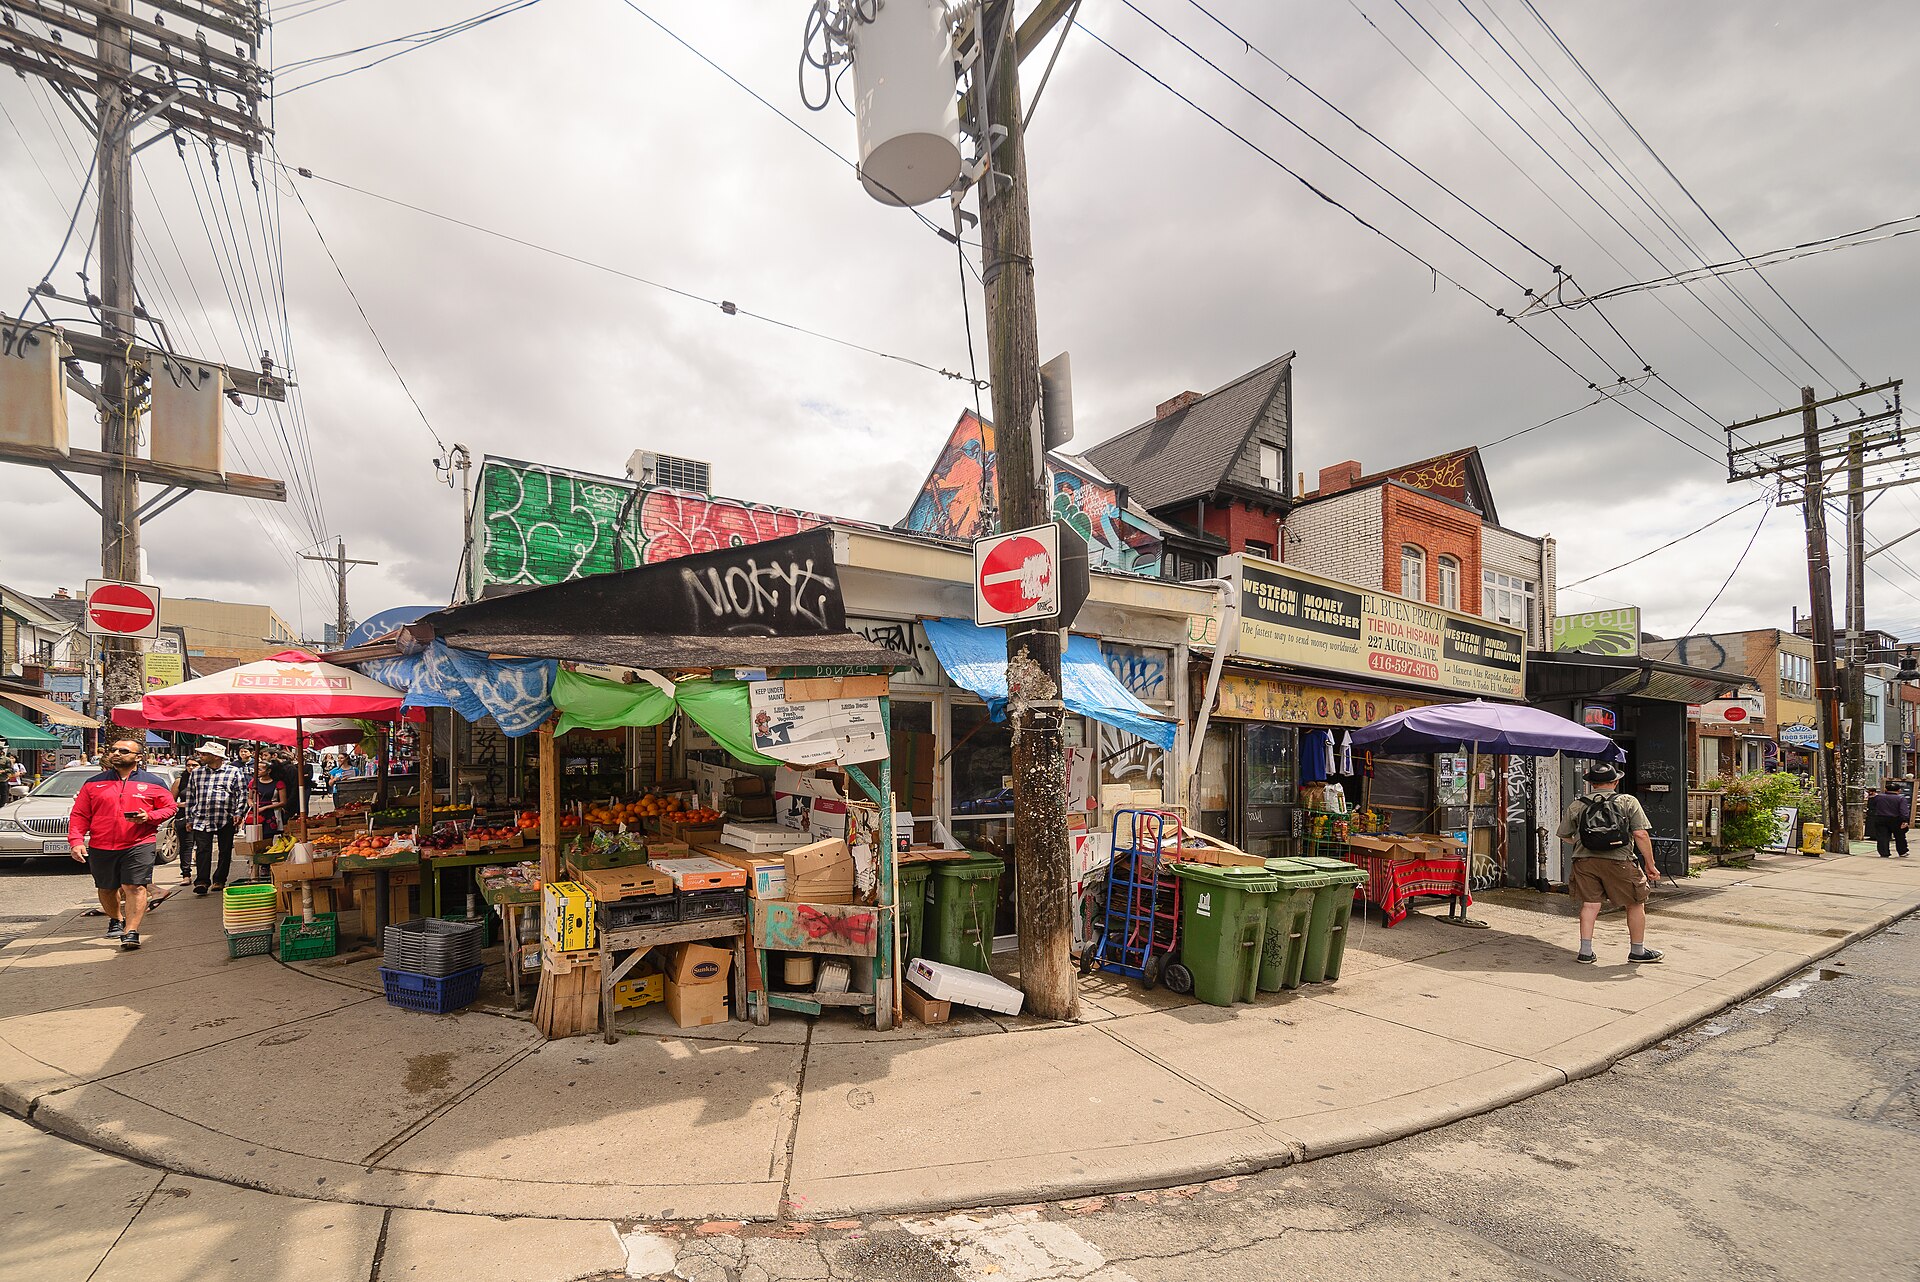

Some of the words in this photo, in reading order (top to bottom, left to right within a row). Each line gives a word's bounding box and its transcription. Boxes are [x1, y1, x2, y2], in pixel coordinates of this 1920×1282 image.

[1243, 579, 1296, 603] WESTERN
[1258, 596, 1296, 616] UNION
[1304, 594, 1344, 613] MONEY
[1362, 594, 1378, 615] EL
[1380, 598, 1410, 622] BUEN
[1412, 606, 1446, 632] PRECIO
[1304, 607, 1360, 629] TRANSFER
[1554, 609, 1634, 636] green
[1242, 622, 1253, 635] The
[1254, 625, 1272, 639] fastest
[1274, 631, 1286, 644] way
[1288, 632, 1295, 642] to
[1296, 635, 1309, 646] send
[1310, 639, 1328, 652] money
[1367, 618, 1404, 638] TIENDA
[1406, 626, 1440, 647] HISPANA
[1445, 628, 1480, 645] WESTERN
[1368, 635, 1382, 649] 227
[1384, 638, 1422, 658] AUGUSTA
[1422, 647, 1438, 662] AVE.
[1454, 640, 1479, 655] UNION
[1485, 638, 1508, 651] DINERO
[1484, 648, 1492, 658] EN
[1494, 650, 1520, 664] MINUTOS
[584, 664, 612, 672] Vegetables
[1371, 655, 1437, 679] 416-597-8716
[1474, 668, 1482, 678] Mas
[242, 676, 343, 688] SLEEMAN
[693, 964, 718, 973] Sunkist
